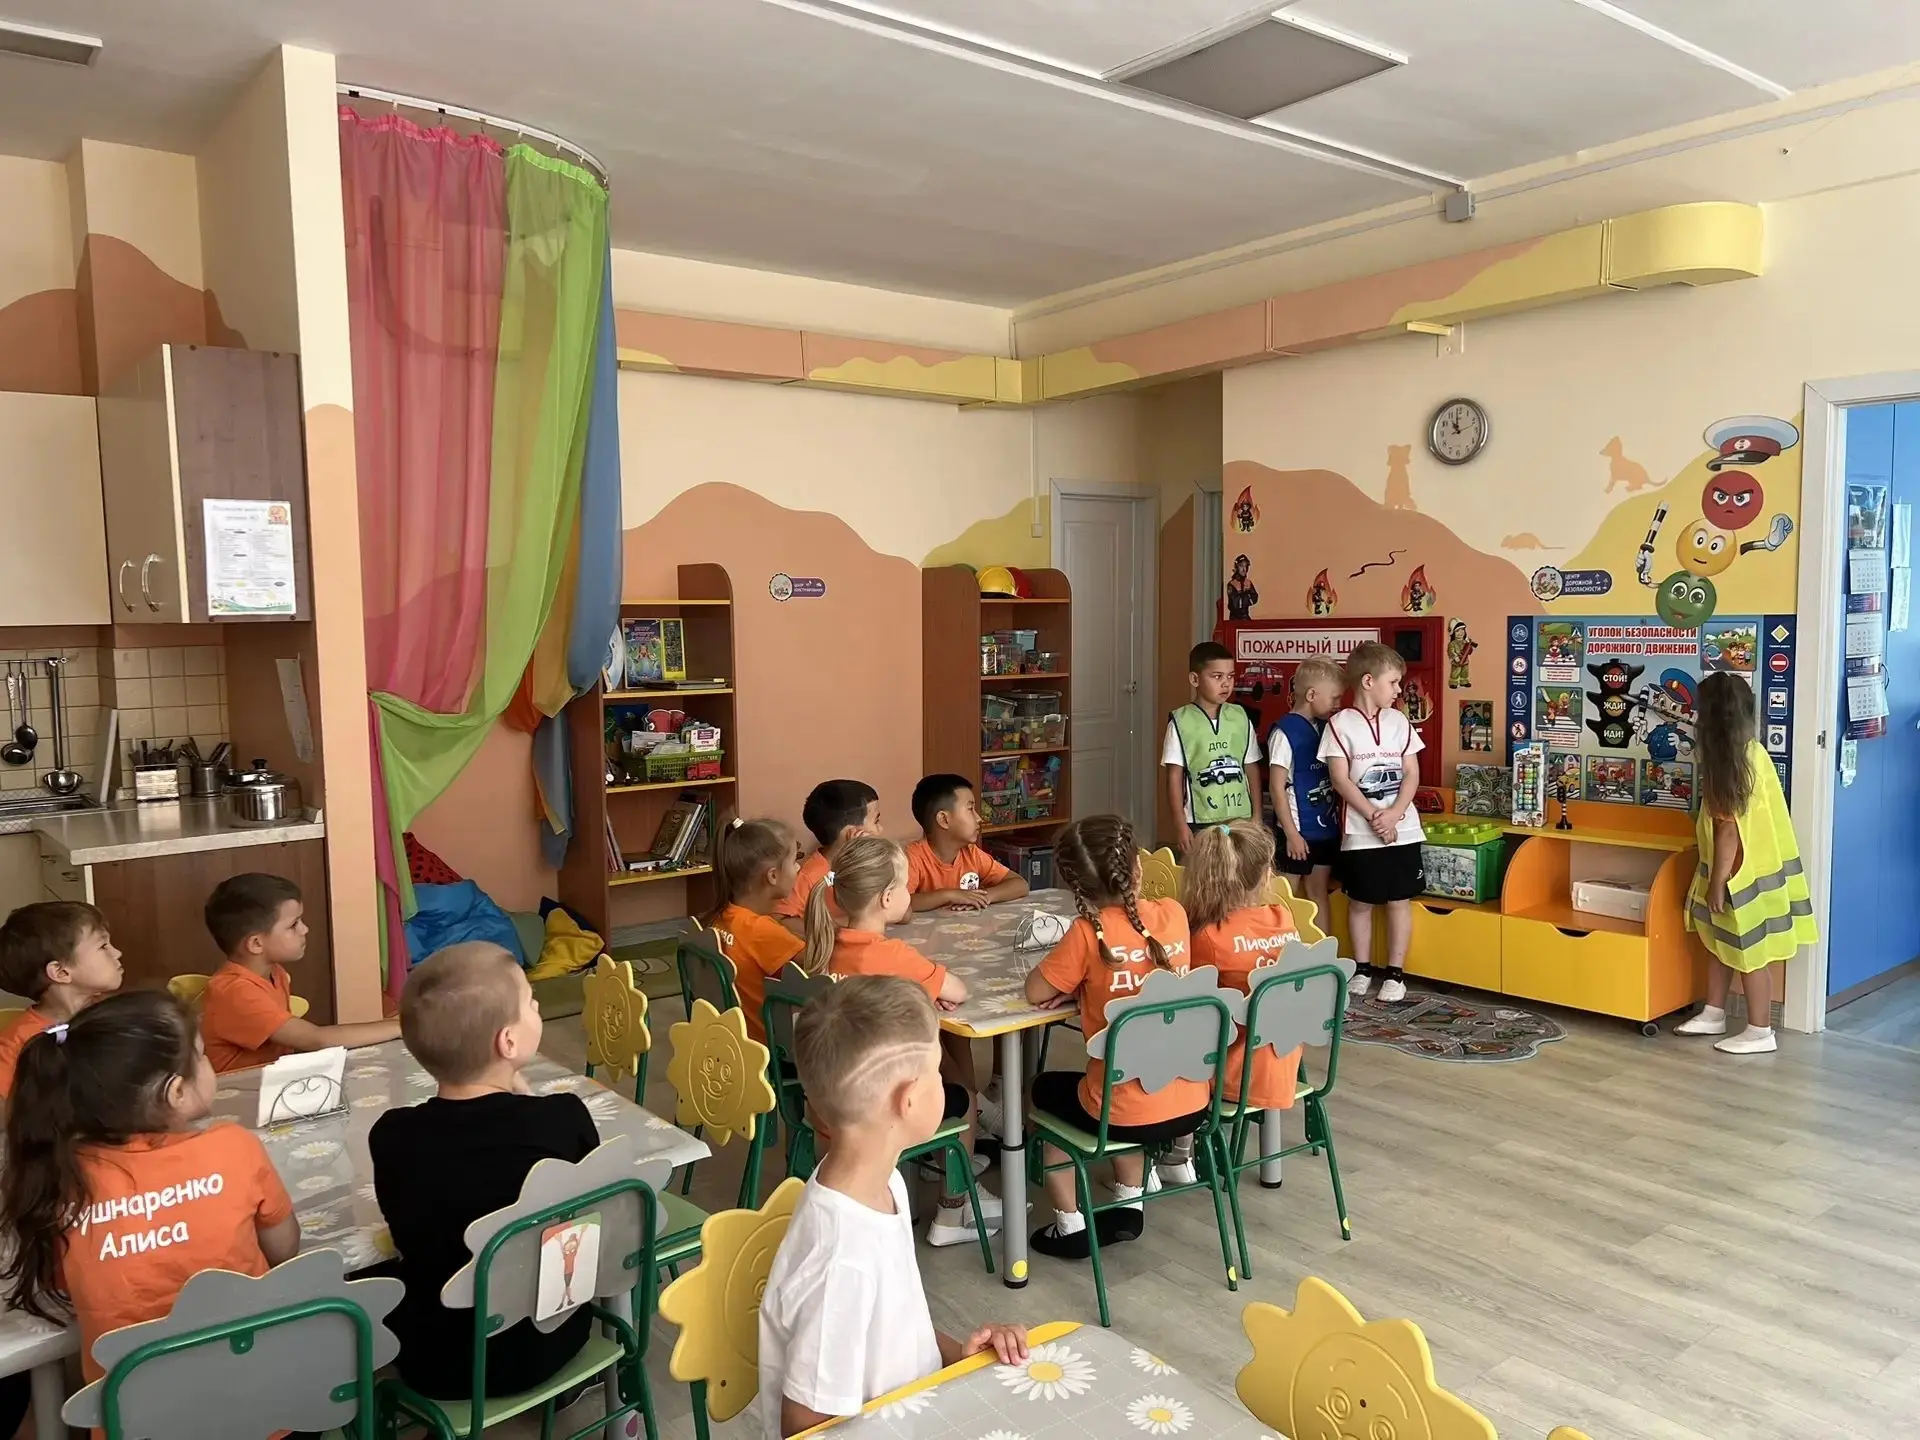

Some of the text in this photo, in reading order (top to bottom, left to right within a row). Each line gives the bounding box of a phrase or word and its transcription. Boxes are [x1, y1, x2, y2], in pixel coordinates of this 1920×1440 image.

[1588, 627, 1697, 638] УГОЛОК БЕЗОПАСНОСТИ
[1243, 636, 1363, 655] ПОЖАРНЫЙ ЩИ
[1587, 643, 1697, 655] ДОРОЖНОГО ДВИЖЕНИЯ
[1603, 672, 1628, 682] СТОЙ!
[1603, 701, 1626, 711] ЖДИ!
[1603, 730, 1624, 739] ИДИ!
[1350, 752, 1376, 761] корая
[1223, 793, 1242, 807] 112
[1110, 940, 1185, 964] Беех
[99, 1221, 190, 1262] Алиса
